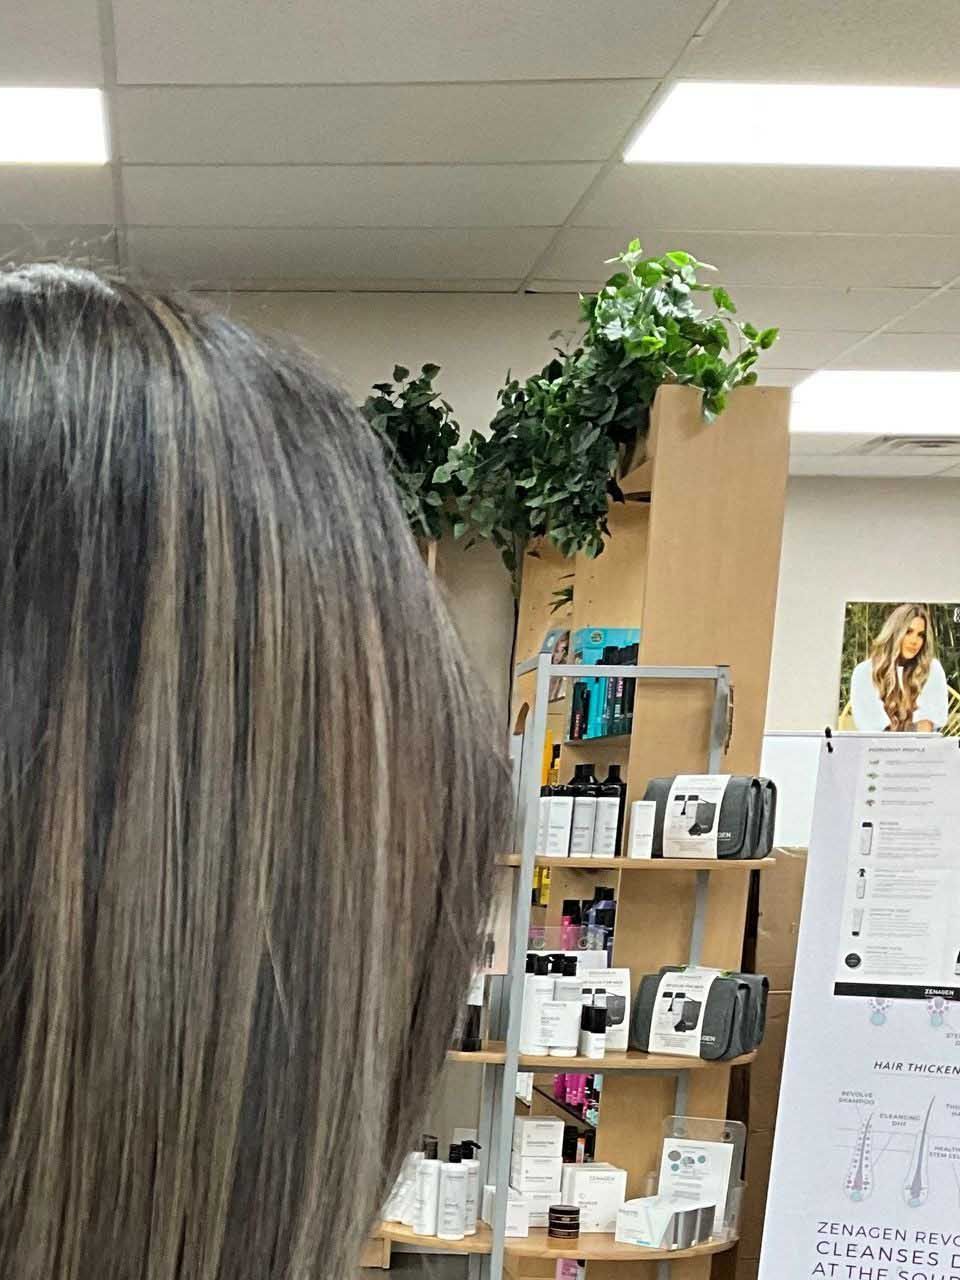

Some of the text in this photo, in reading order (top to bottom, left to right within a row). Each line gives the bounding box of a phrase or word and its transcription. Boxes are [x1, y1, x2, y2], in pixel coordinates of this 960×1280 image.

[873, 1060, 960, 1075] HAIR THICKEN
[817, 1221, 907, 1242] ZENAGEN
[816, 1240, 939, 1266] CLEANSES
[811, 1262, 839, 1277] AT
